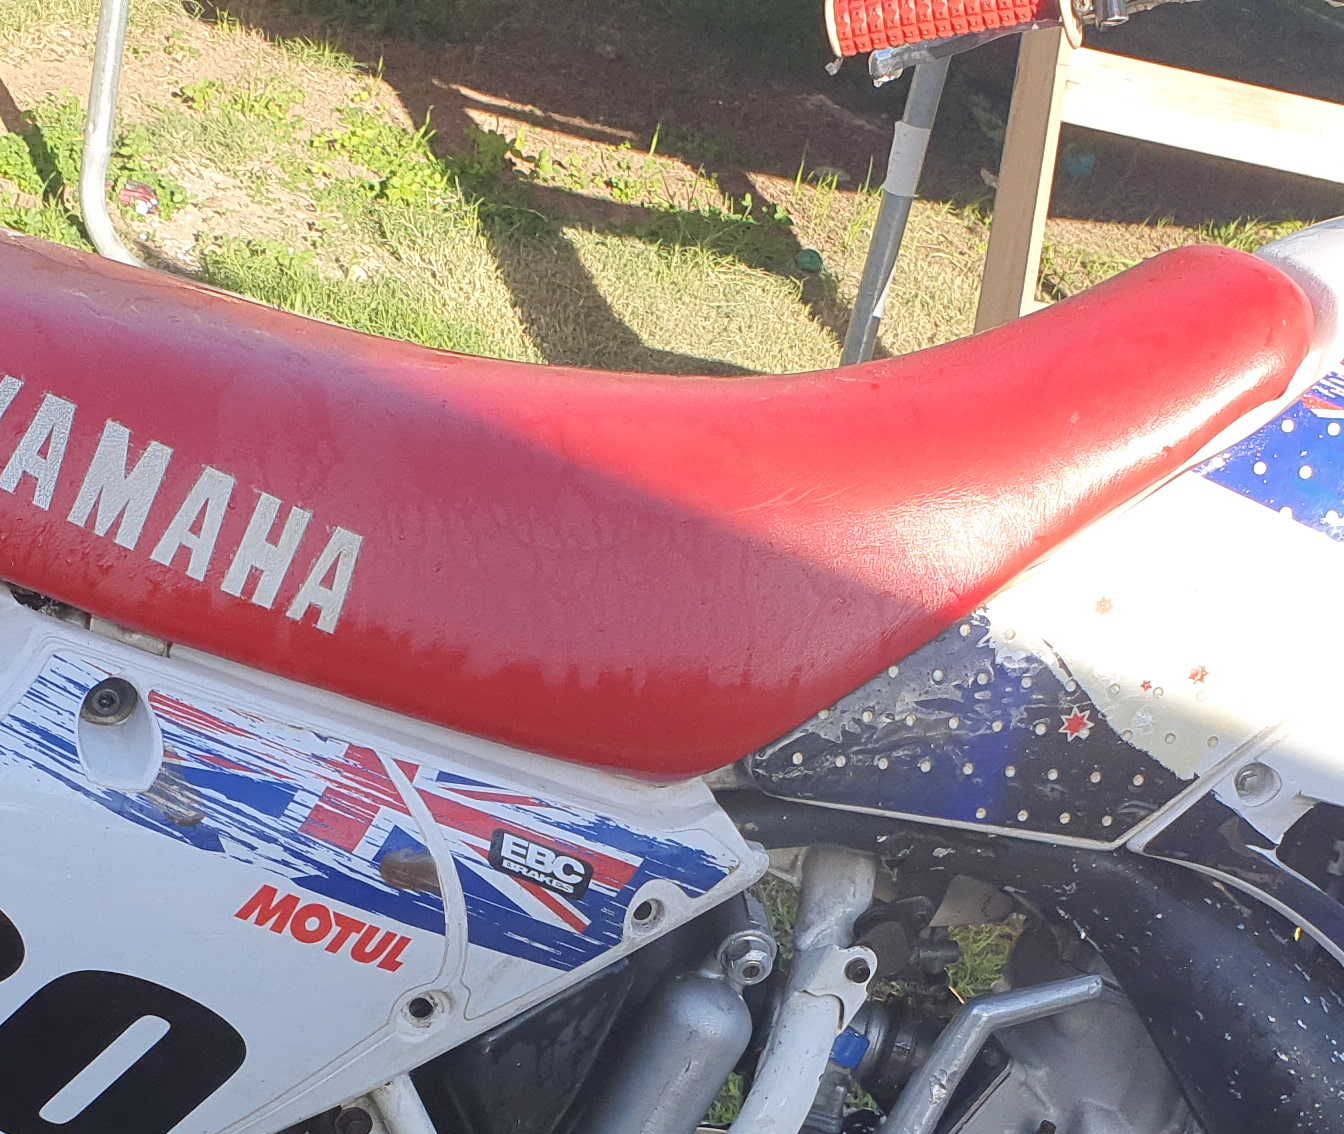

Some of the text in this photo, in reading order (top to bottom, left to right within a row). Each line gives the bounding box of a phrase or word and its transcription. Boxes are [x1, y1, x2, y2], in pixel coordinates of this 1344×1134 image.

[501, 833, 585, 883] EBC
[502, 859, 574, 893] BRAKES
[234, 884, 413, 972] MOTUL
